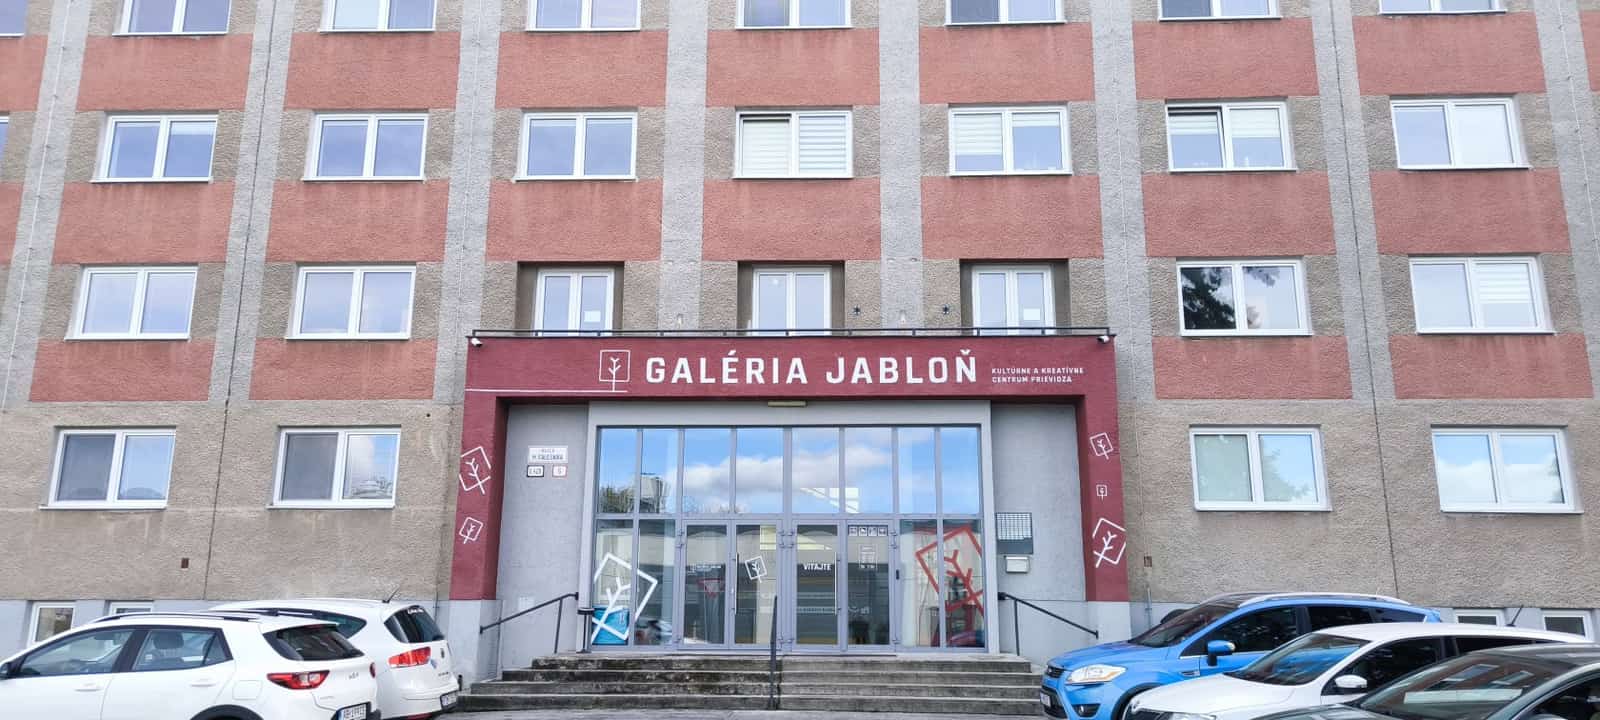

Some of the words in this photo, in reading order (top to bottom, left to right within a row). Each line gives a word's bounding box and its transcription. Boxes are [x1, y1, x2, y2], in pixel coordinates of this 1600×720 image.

[645, 350, 808, 384] GALÉRIA
[825, 349, 977, 384] JABLOŇ
[803, 562, 832, 571] VITAJTE
